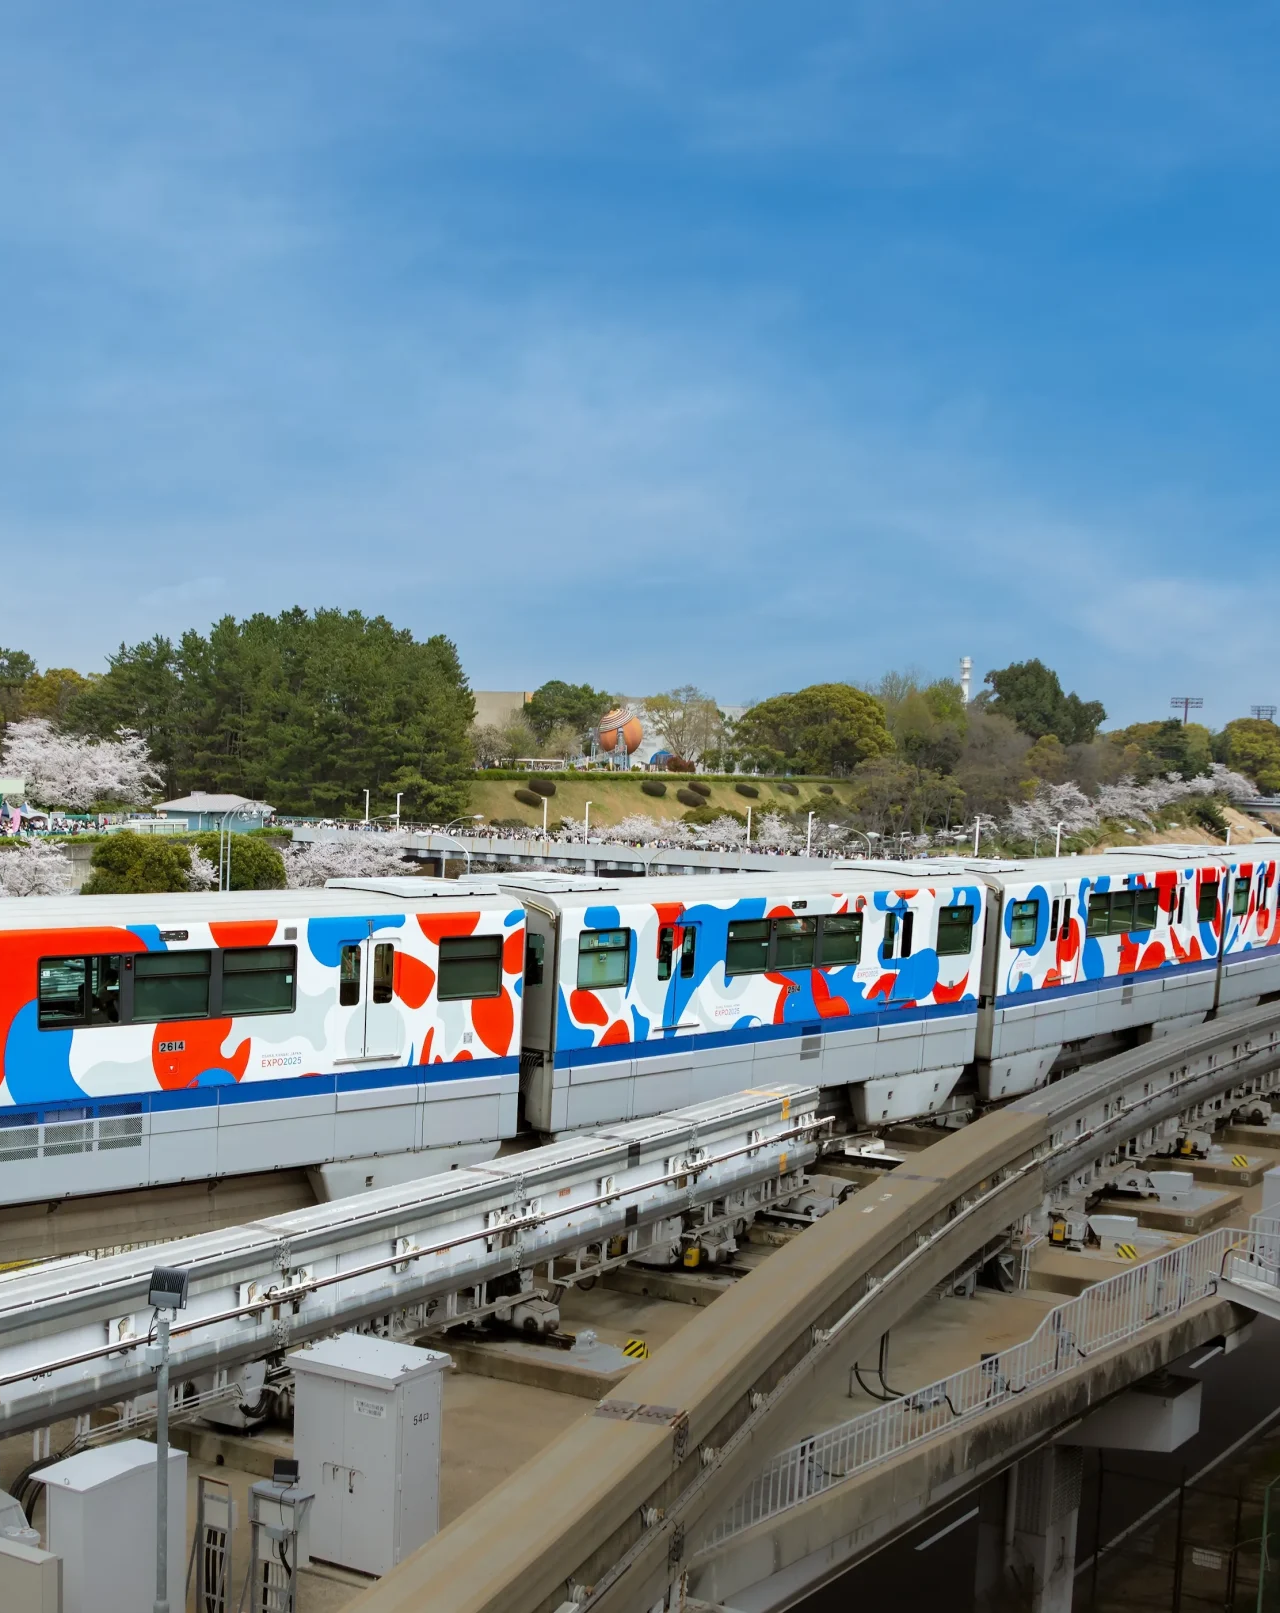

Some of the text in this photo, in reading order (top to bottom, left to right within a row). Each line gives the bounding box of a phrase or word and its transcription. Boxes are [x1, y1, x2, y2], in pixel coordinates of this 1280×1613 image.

[714, 1007, 740, 1017] EXPO2025
[160, 1041, 185, 1052] 2614
[261, 1056, 302, 1068] EXPO2025
